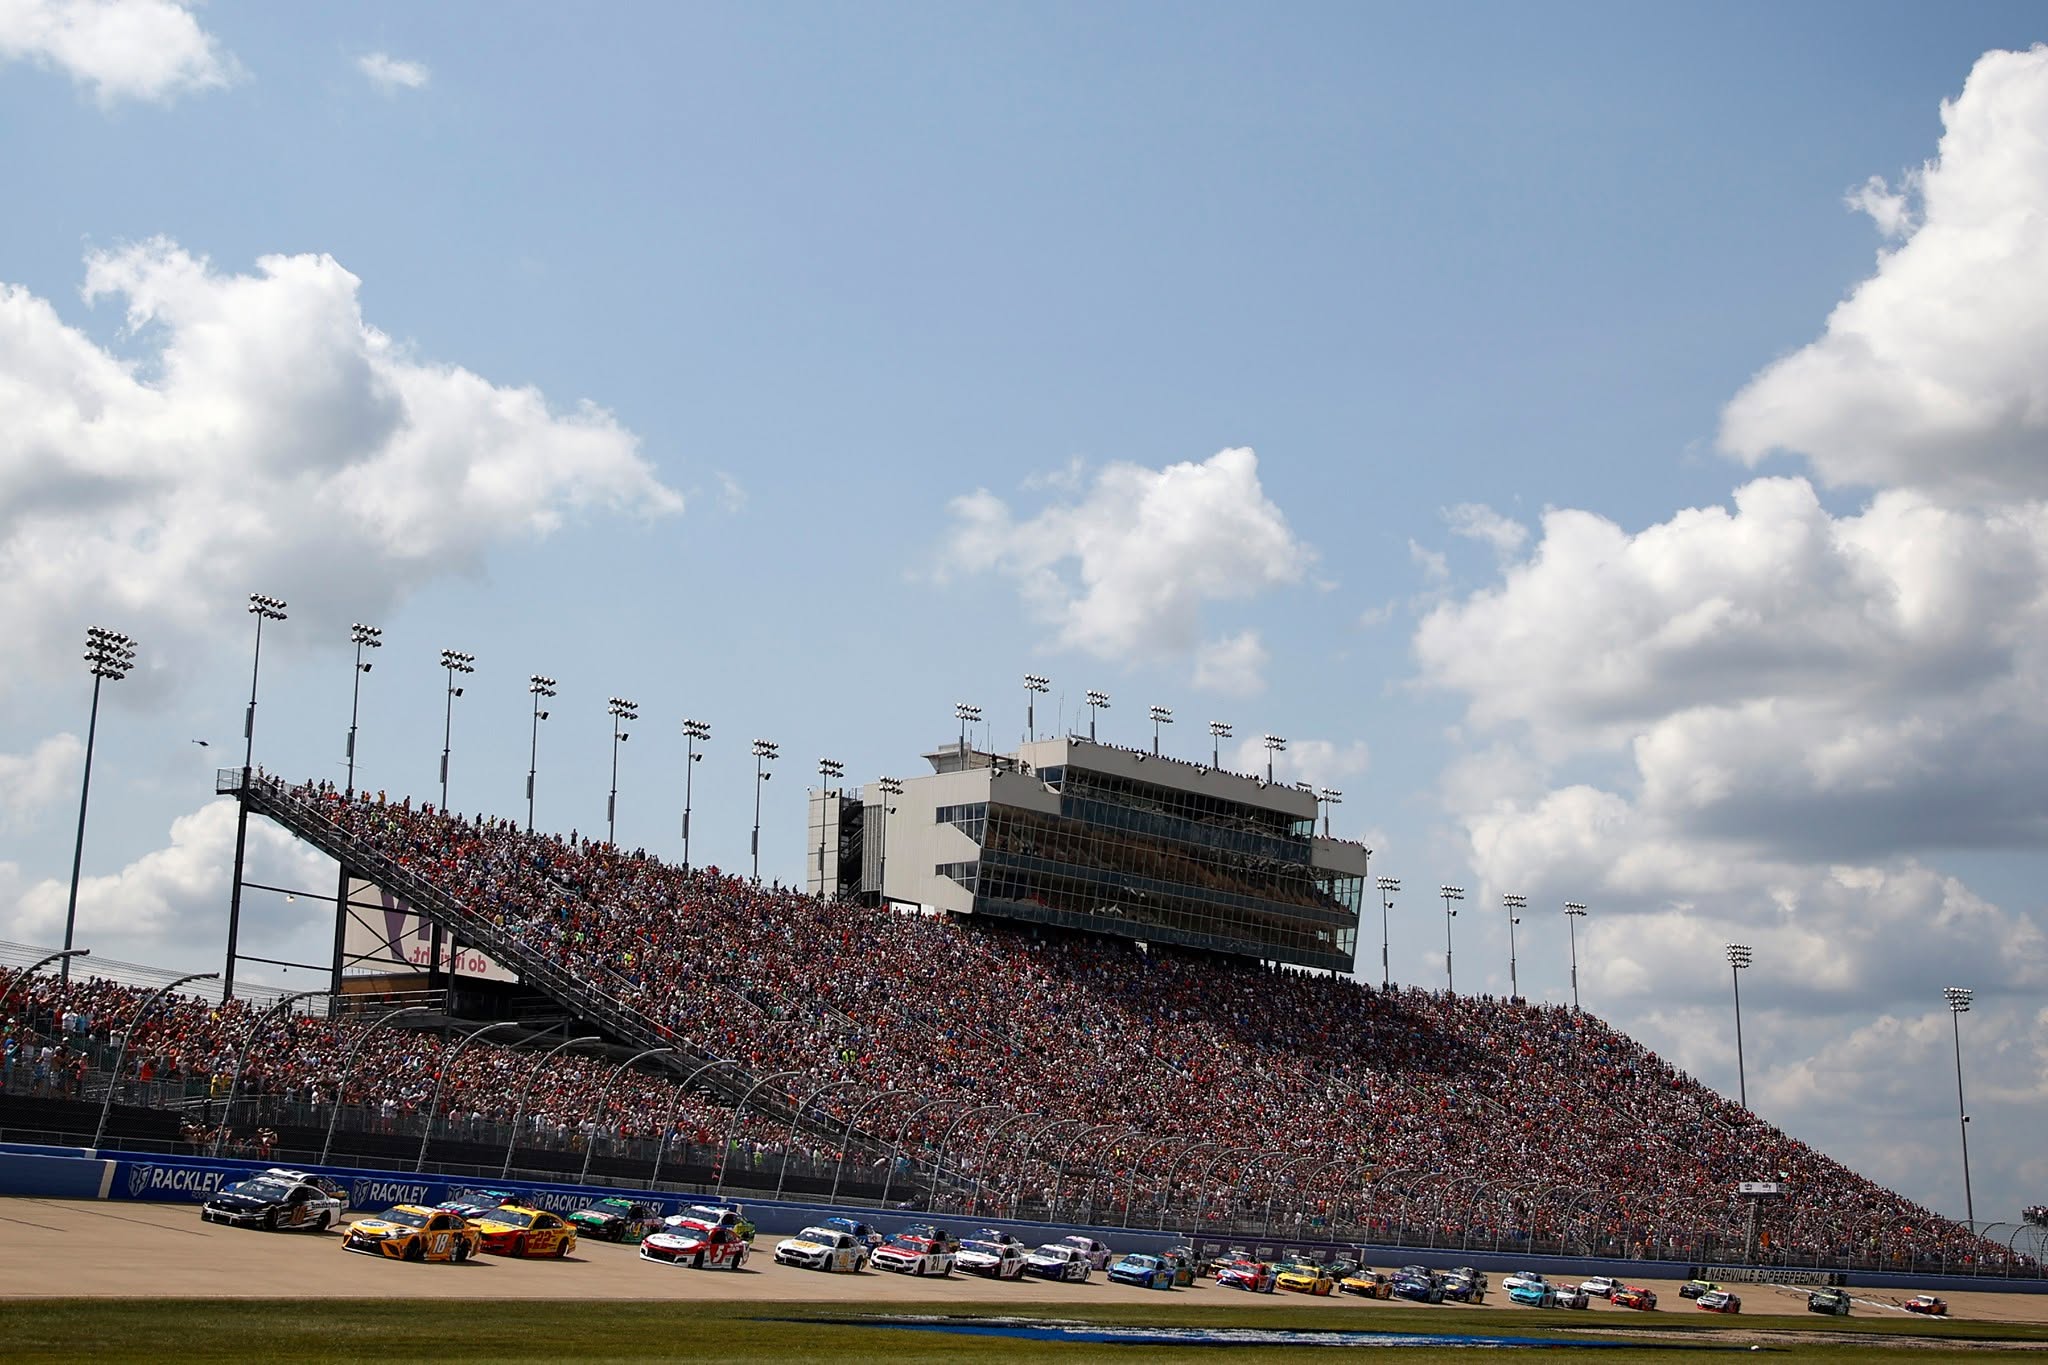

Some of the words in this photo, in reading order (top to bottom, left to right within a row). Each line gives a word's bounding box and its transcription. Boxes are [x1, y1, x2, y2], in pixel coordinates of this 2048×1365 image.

[151, 1168, 225, 1192] RACKLEY
[369, 1183, 429, 1203] RACKLEY
[544, 1194, 593, 1212] RACKLEY
[432, 1233, 450, 1254] 18
[530, 1230, 552, 1250] 22
[712, 1244, 725, 1263] 5
[931, 1255, 941, 1271] 21
[1710, 1267, 1756, 1281] NASHVILLE
[1758, 1270, 1825, 1285] SUPERSPEEDWAY
